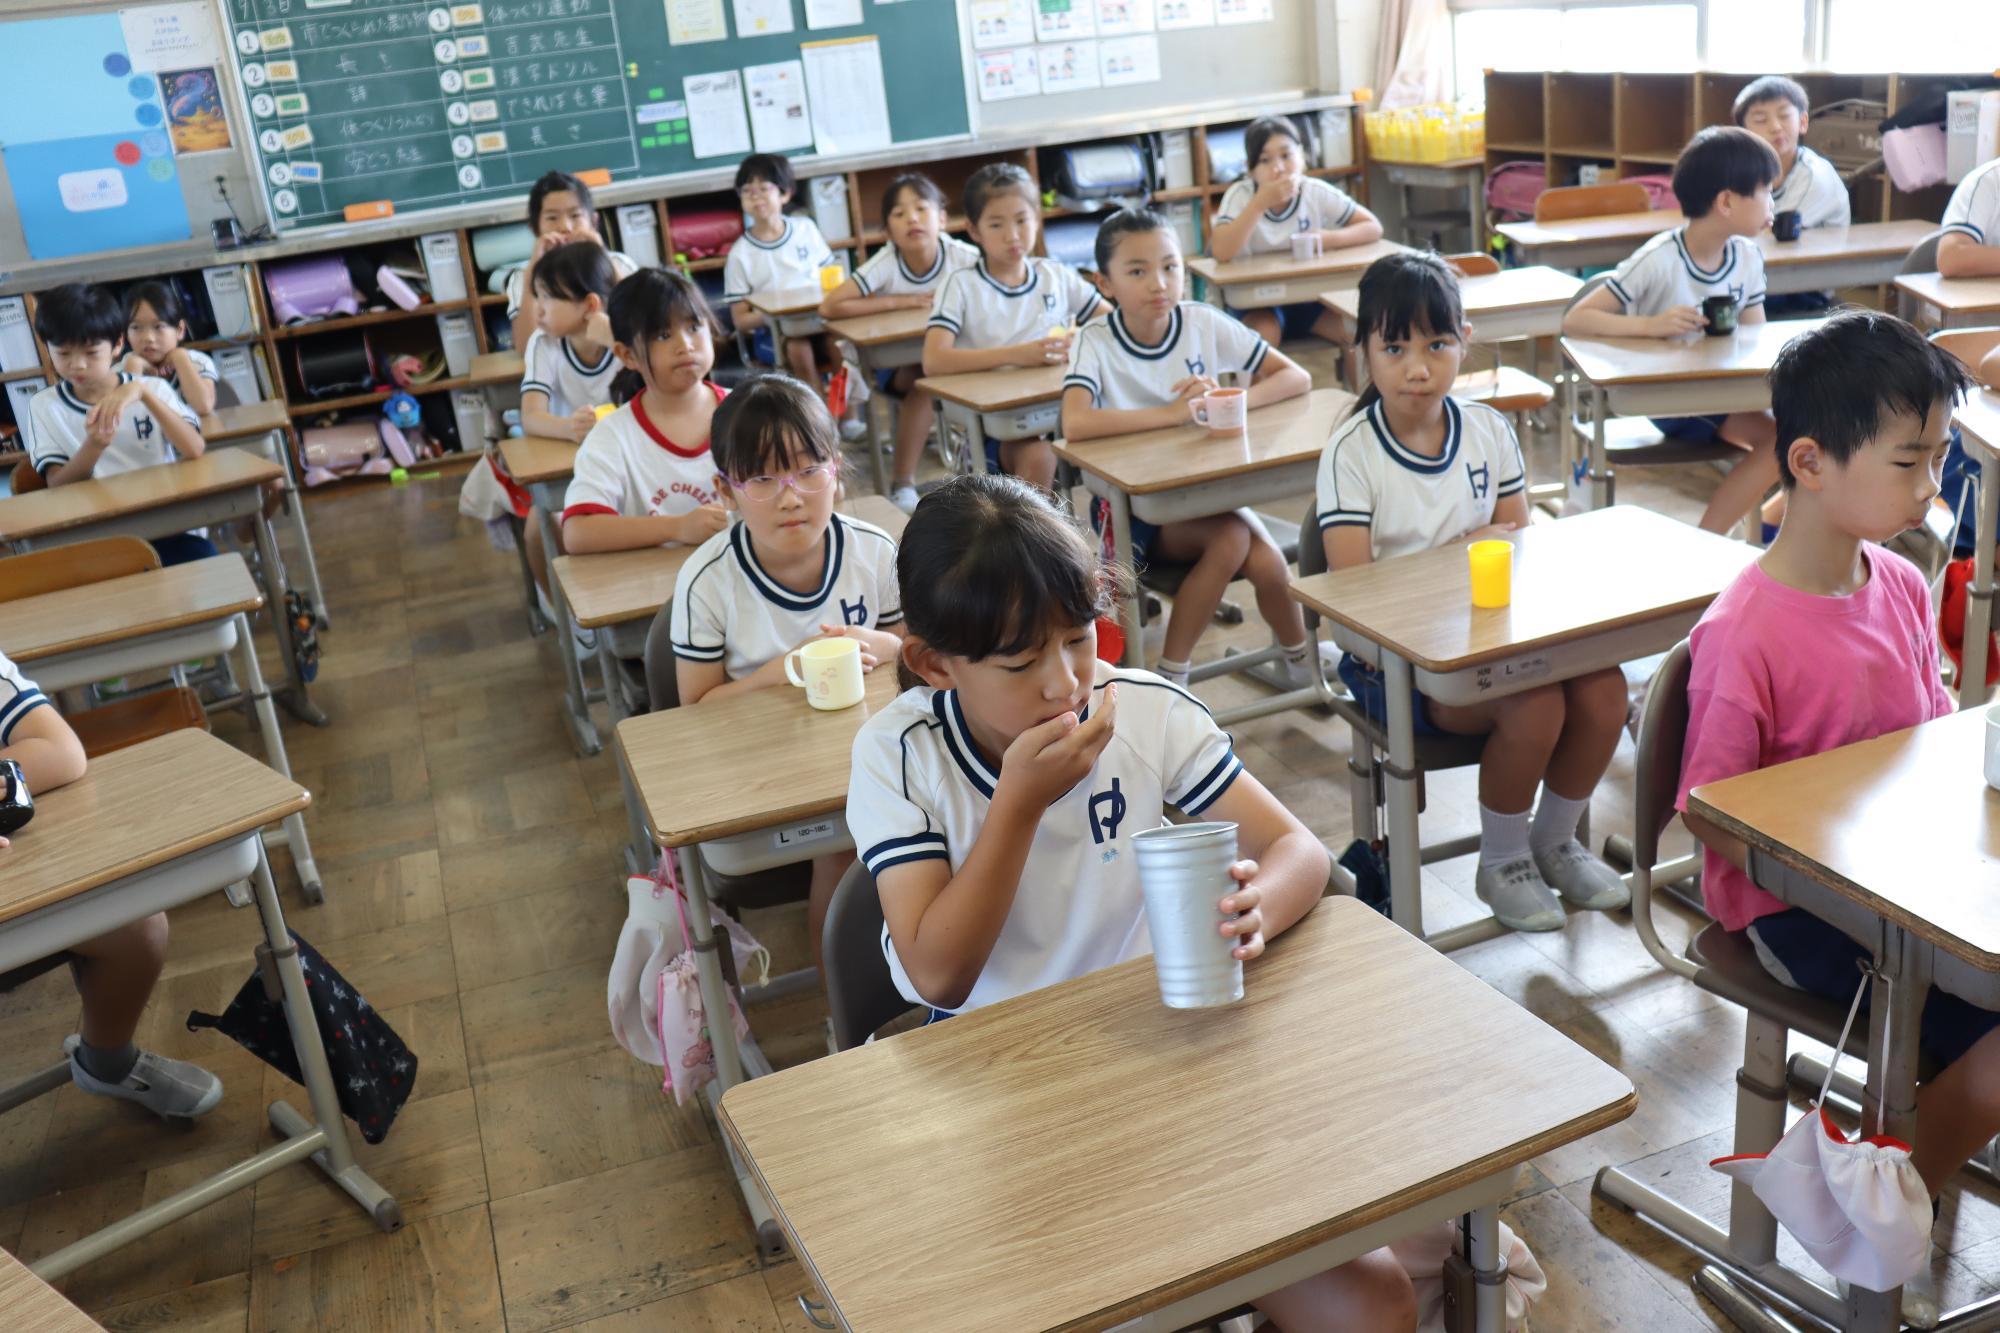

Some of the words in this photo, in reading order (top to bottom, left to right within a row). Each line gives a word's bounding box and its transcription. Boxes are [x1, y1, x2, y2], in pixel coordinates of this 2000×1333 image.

[651, 488, 668, 506] BE
[1505, 664, 1513, 675] L
[780, 831, 790, 843] L
